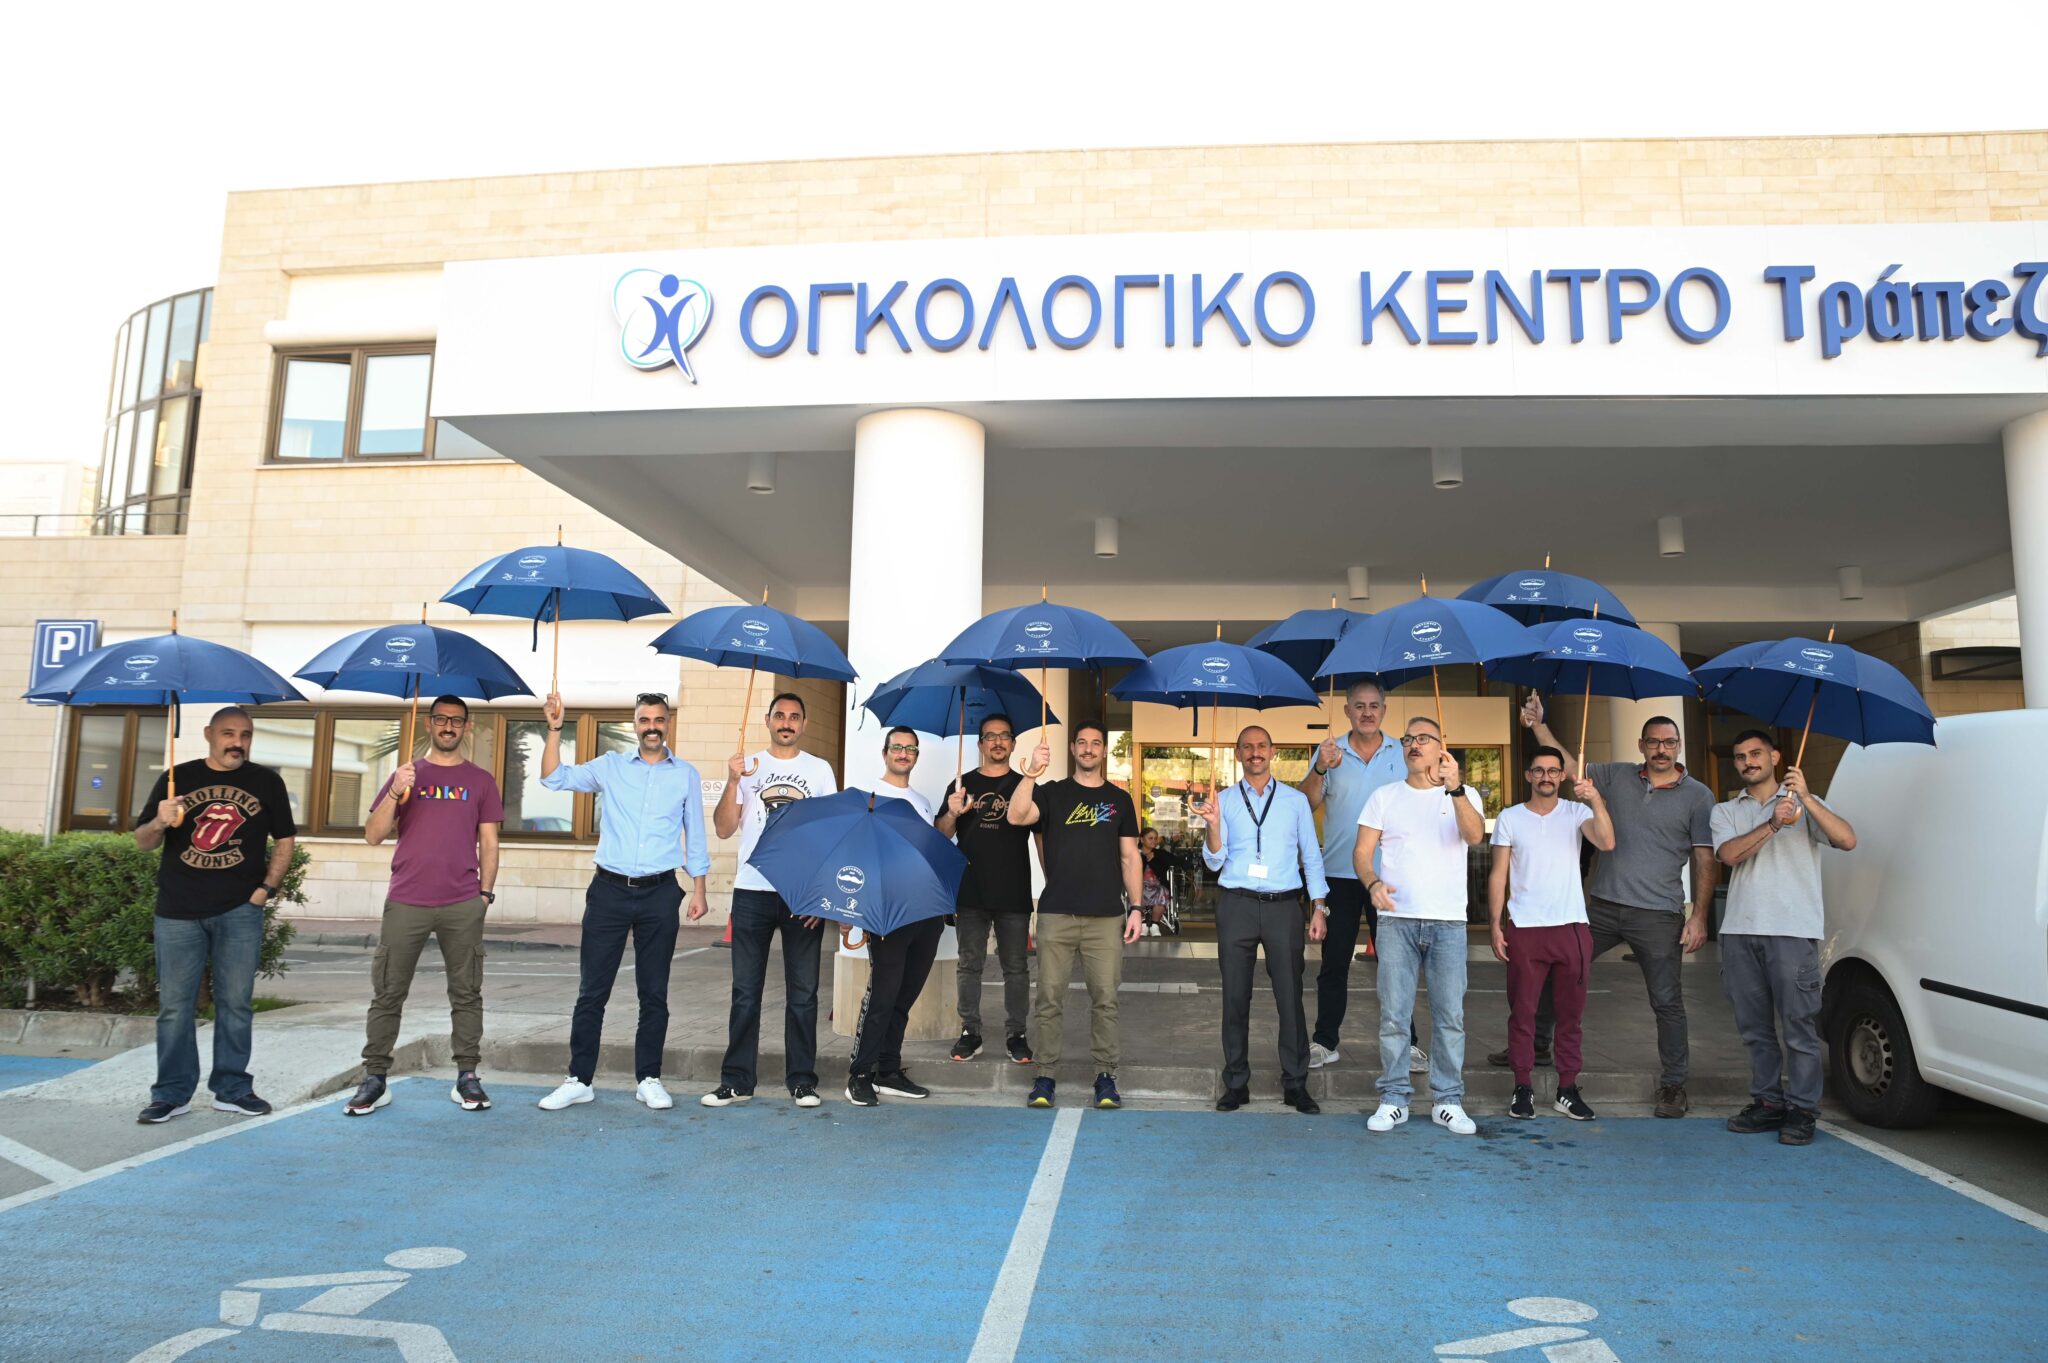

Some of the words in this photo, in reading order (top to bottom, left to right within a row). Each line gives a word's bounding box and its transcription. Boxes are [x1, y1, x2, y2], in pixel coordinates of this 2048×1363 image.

[739, 270, 1316, 357] ΟΓΚΟΛΟΓΙΚΟ
[1360, 266, 1732, 344] ΚΕΝΤΡΟ
[51, 630, 77, 663] P
[1403, 651, 1416, 661] 25
[183, 786, 258, 815] ROLLING
[182, 848, 242, 869] STONES
[820, 897, 832, 911] 25
